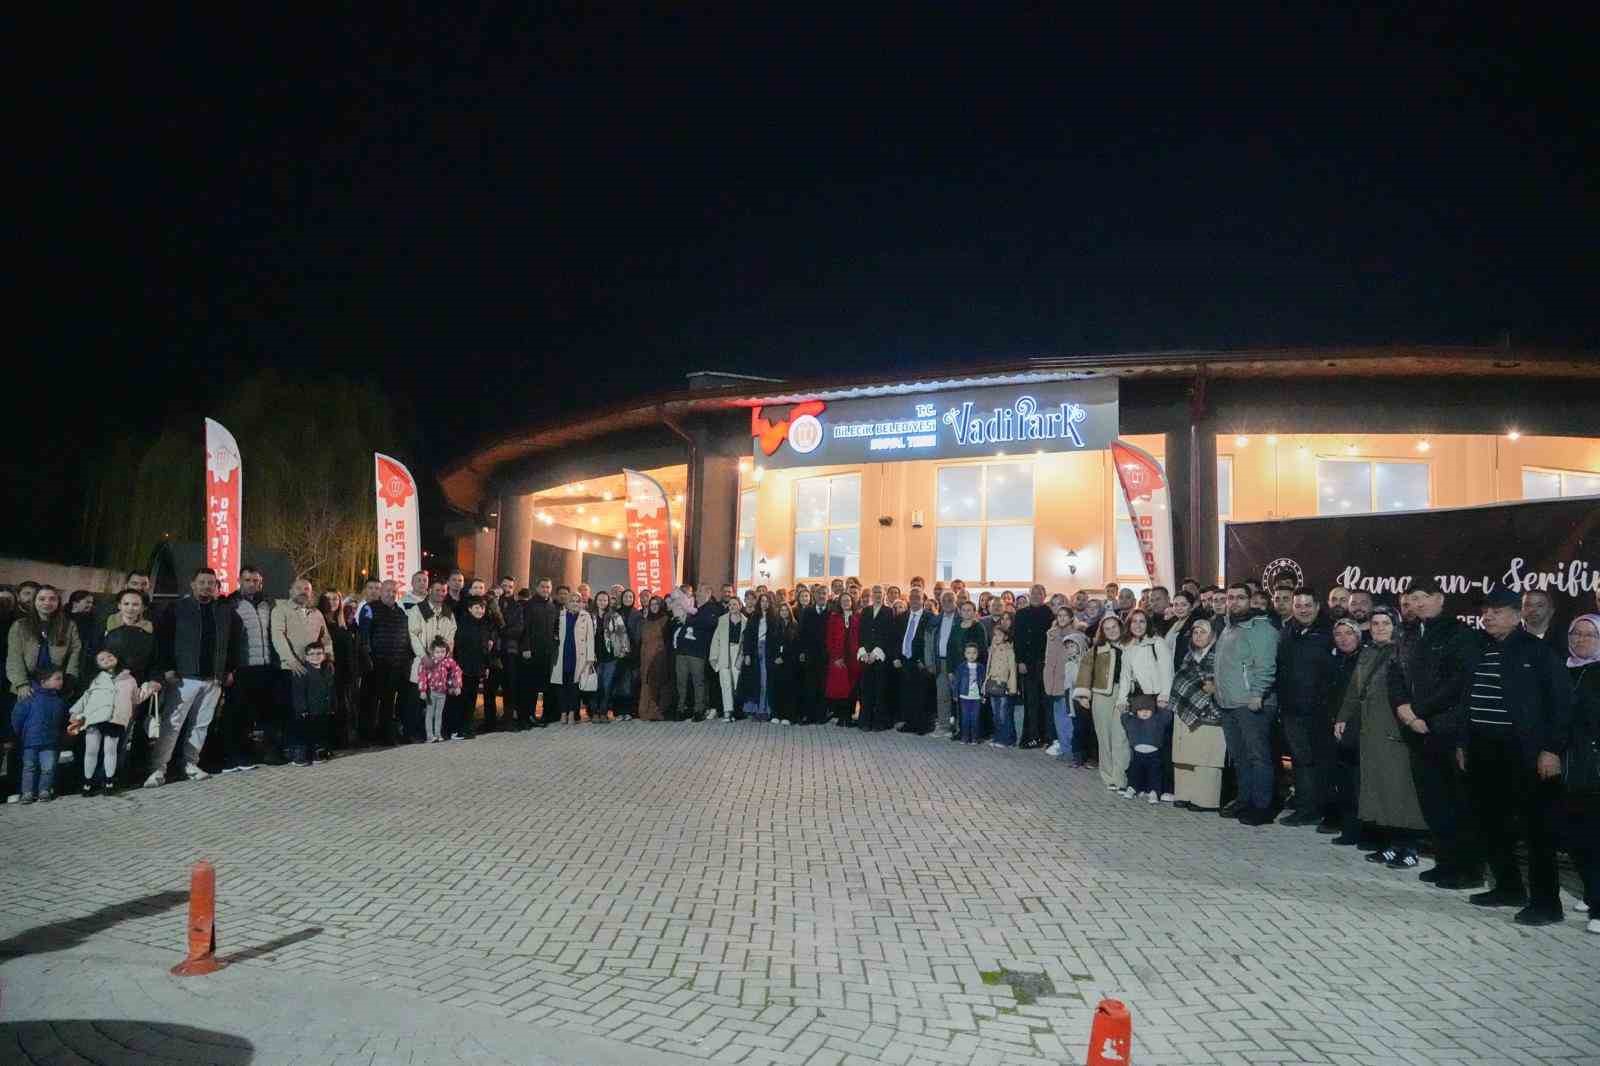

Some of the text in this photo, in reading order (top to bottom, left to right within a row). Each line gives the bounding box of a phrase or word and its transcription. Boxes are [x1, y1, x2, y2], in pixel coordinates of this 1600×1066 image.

[943, 396, 1087, 447] Vadi Park
[1336, 565, 1495, 595] Ramaan-ı
